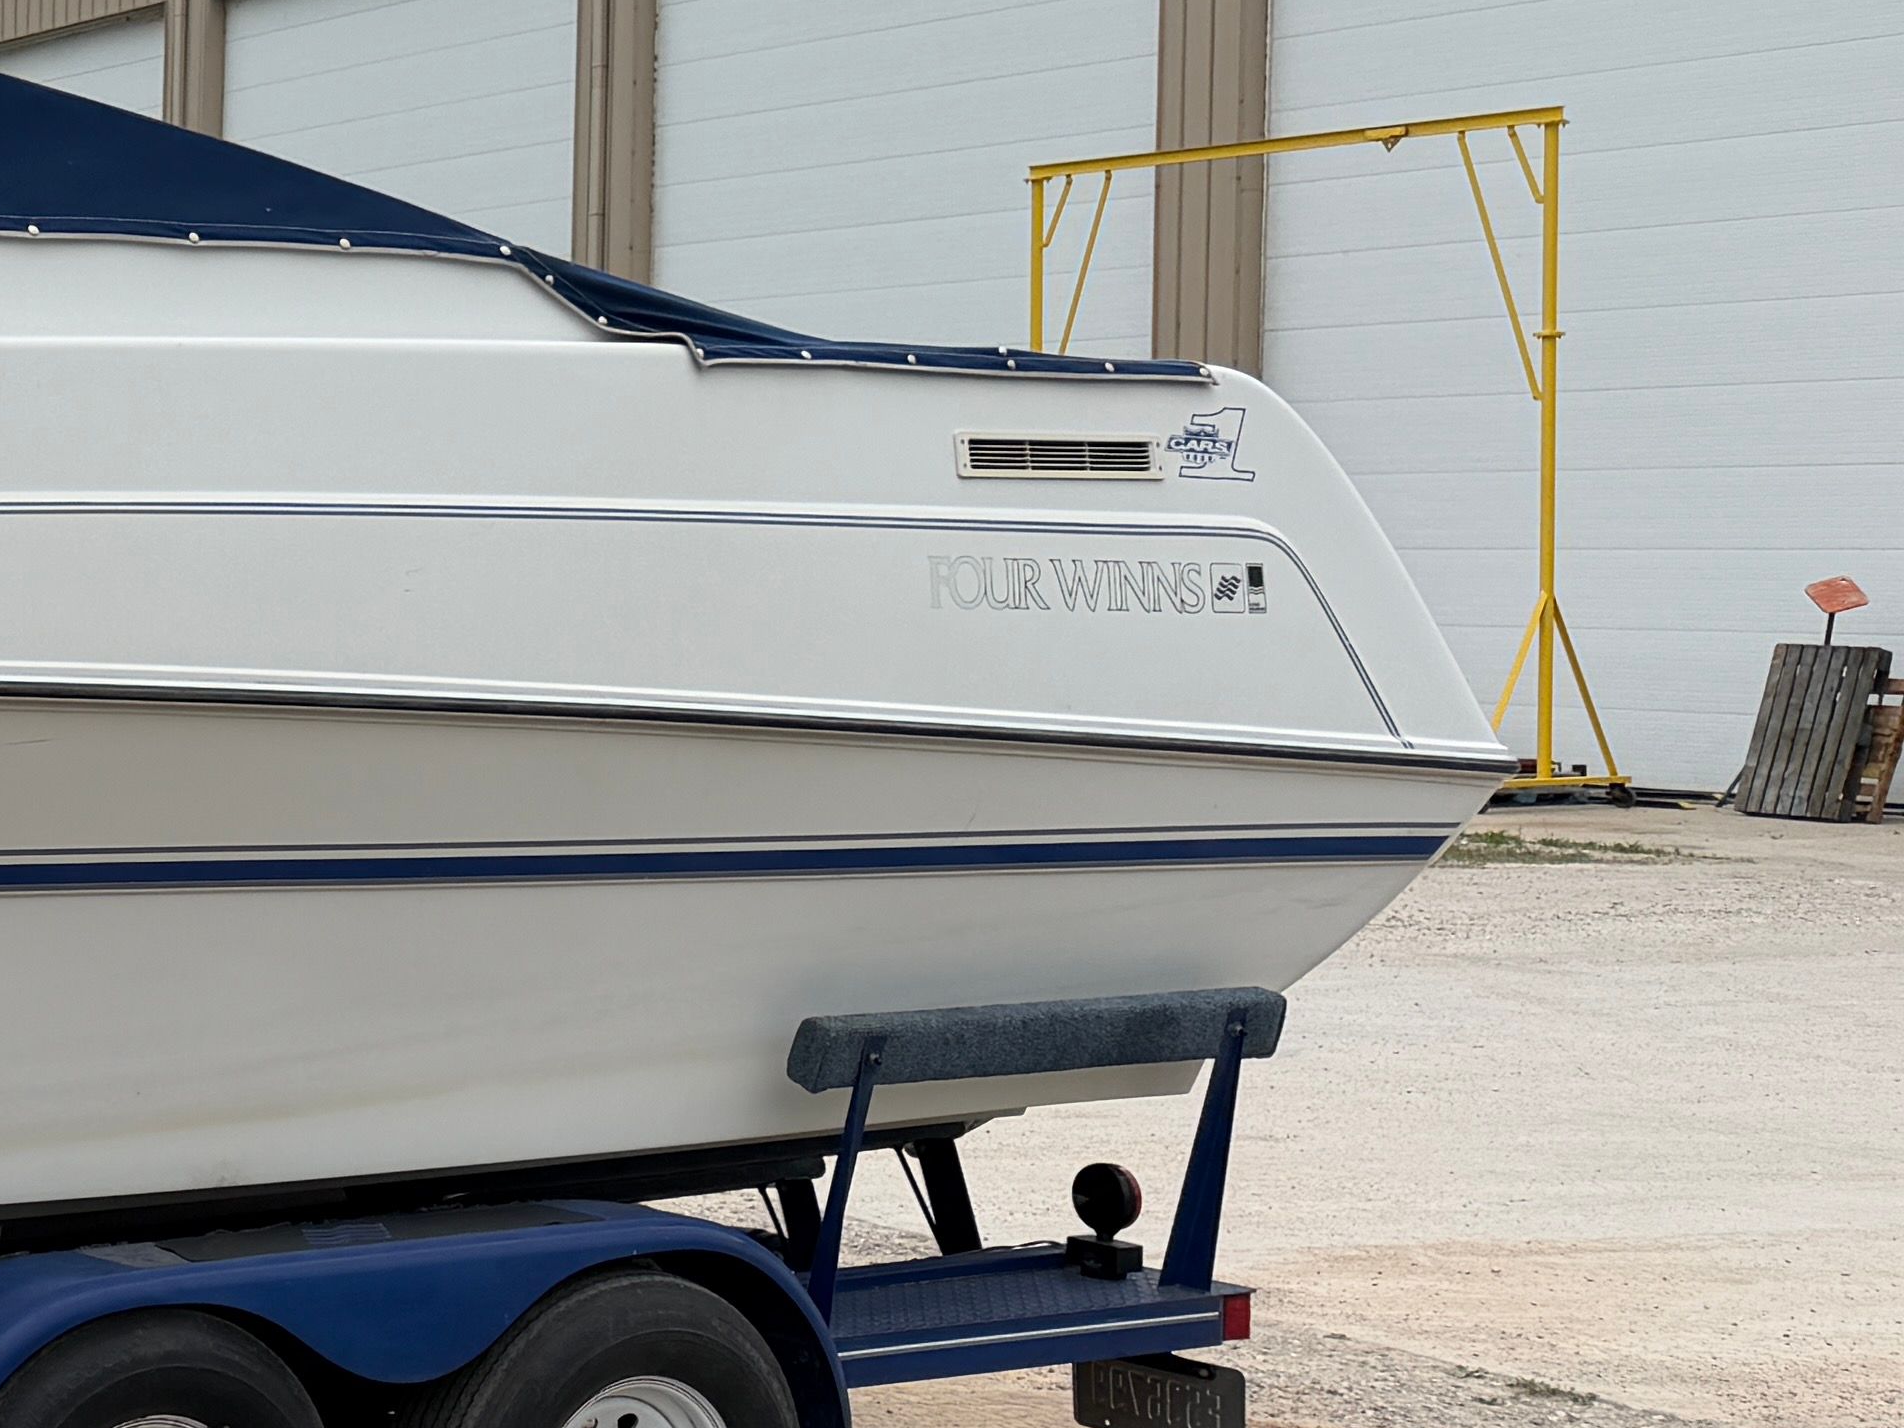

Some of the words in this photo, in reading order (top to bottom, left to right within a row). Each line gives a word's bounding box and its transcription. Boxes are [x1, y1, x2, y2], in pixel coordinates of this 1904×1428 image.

[1169, 438, 1229, 453] CARS
[927, 555, 1051, 611] FOUR
[1049, 558, 1206, 615] WINNS
